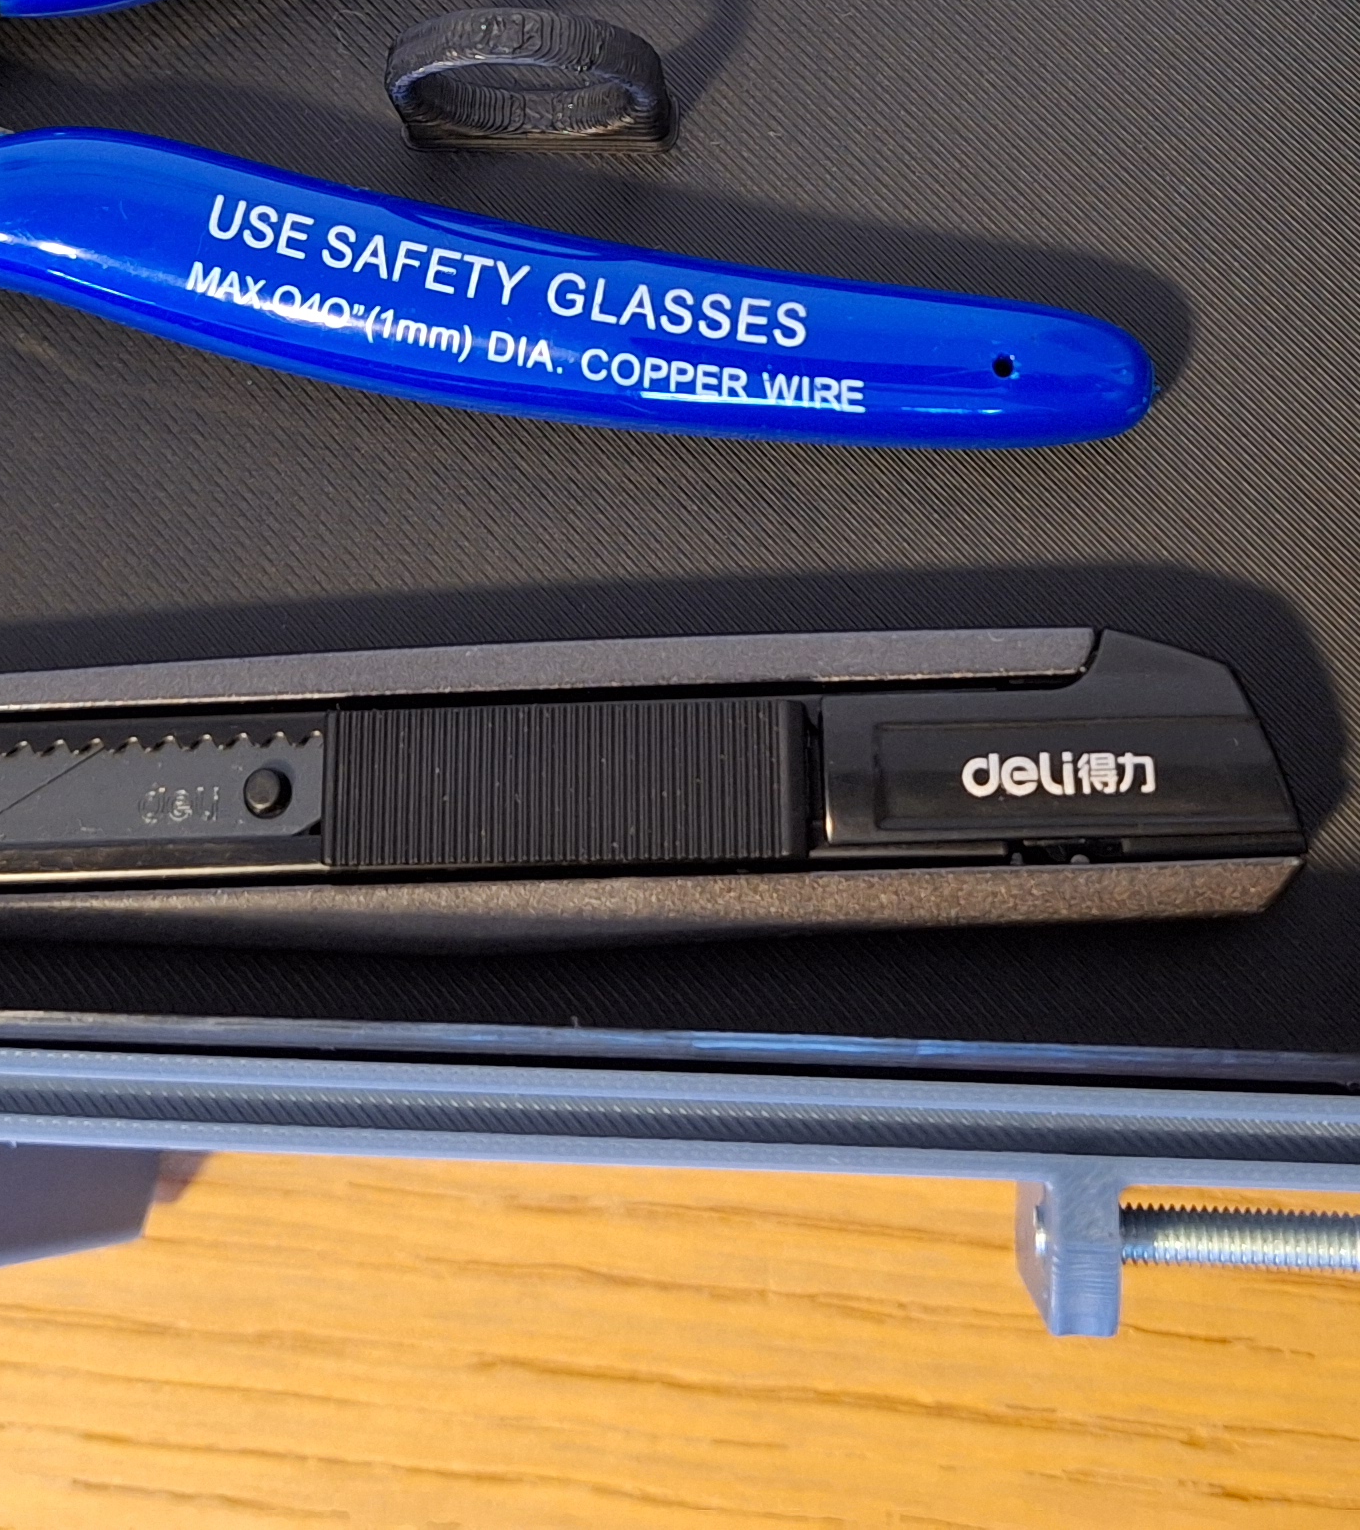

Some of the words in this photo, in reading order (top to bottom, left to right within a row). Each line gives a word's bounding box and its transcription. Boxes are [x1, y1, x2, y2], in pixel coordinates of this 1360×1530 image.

[207, 193, 315, 260] USE
[321, 224, 531, 306] SAFETY
[546, 271, 808, 348] GLASSES
[486, 330, 564, 375] DIA.
[580, 347, 749, 399] COPPER
[761, 370, 867, 414] WIRE
